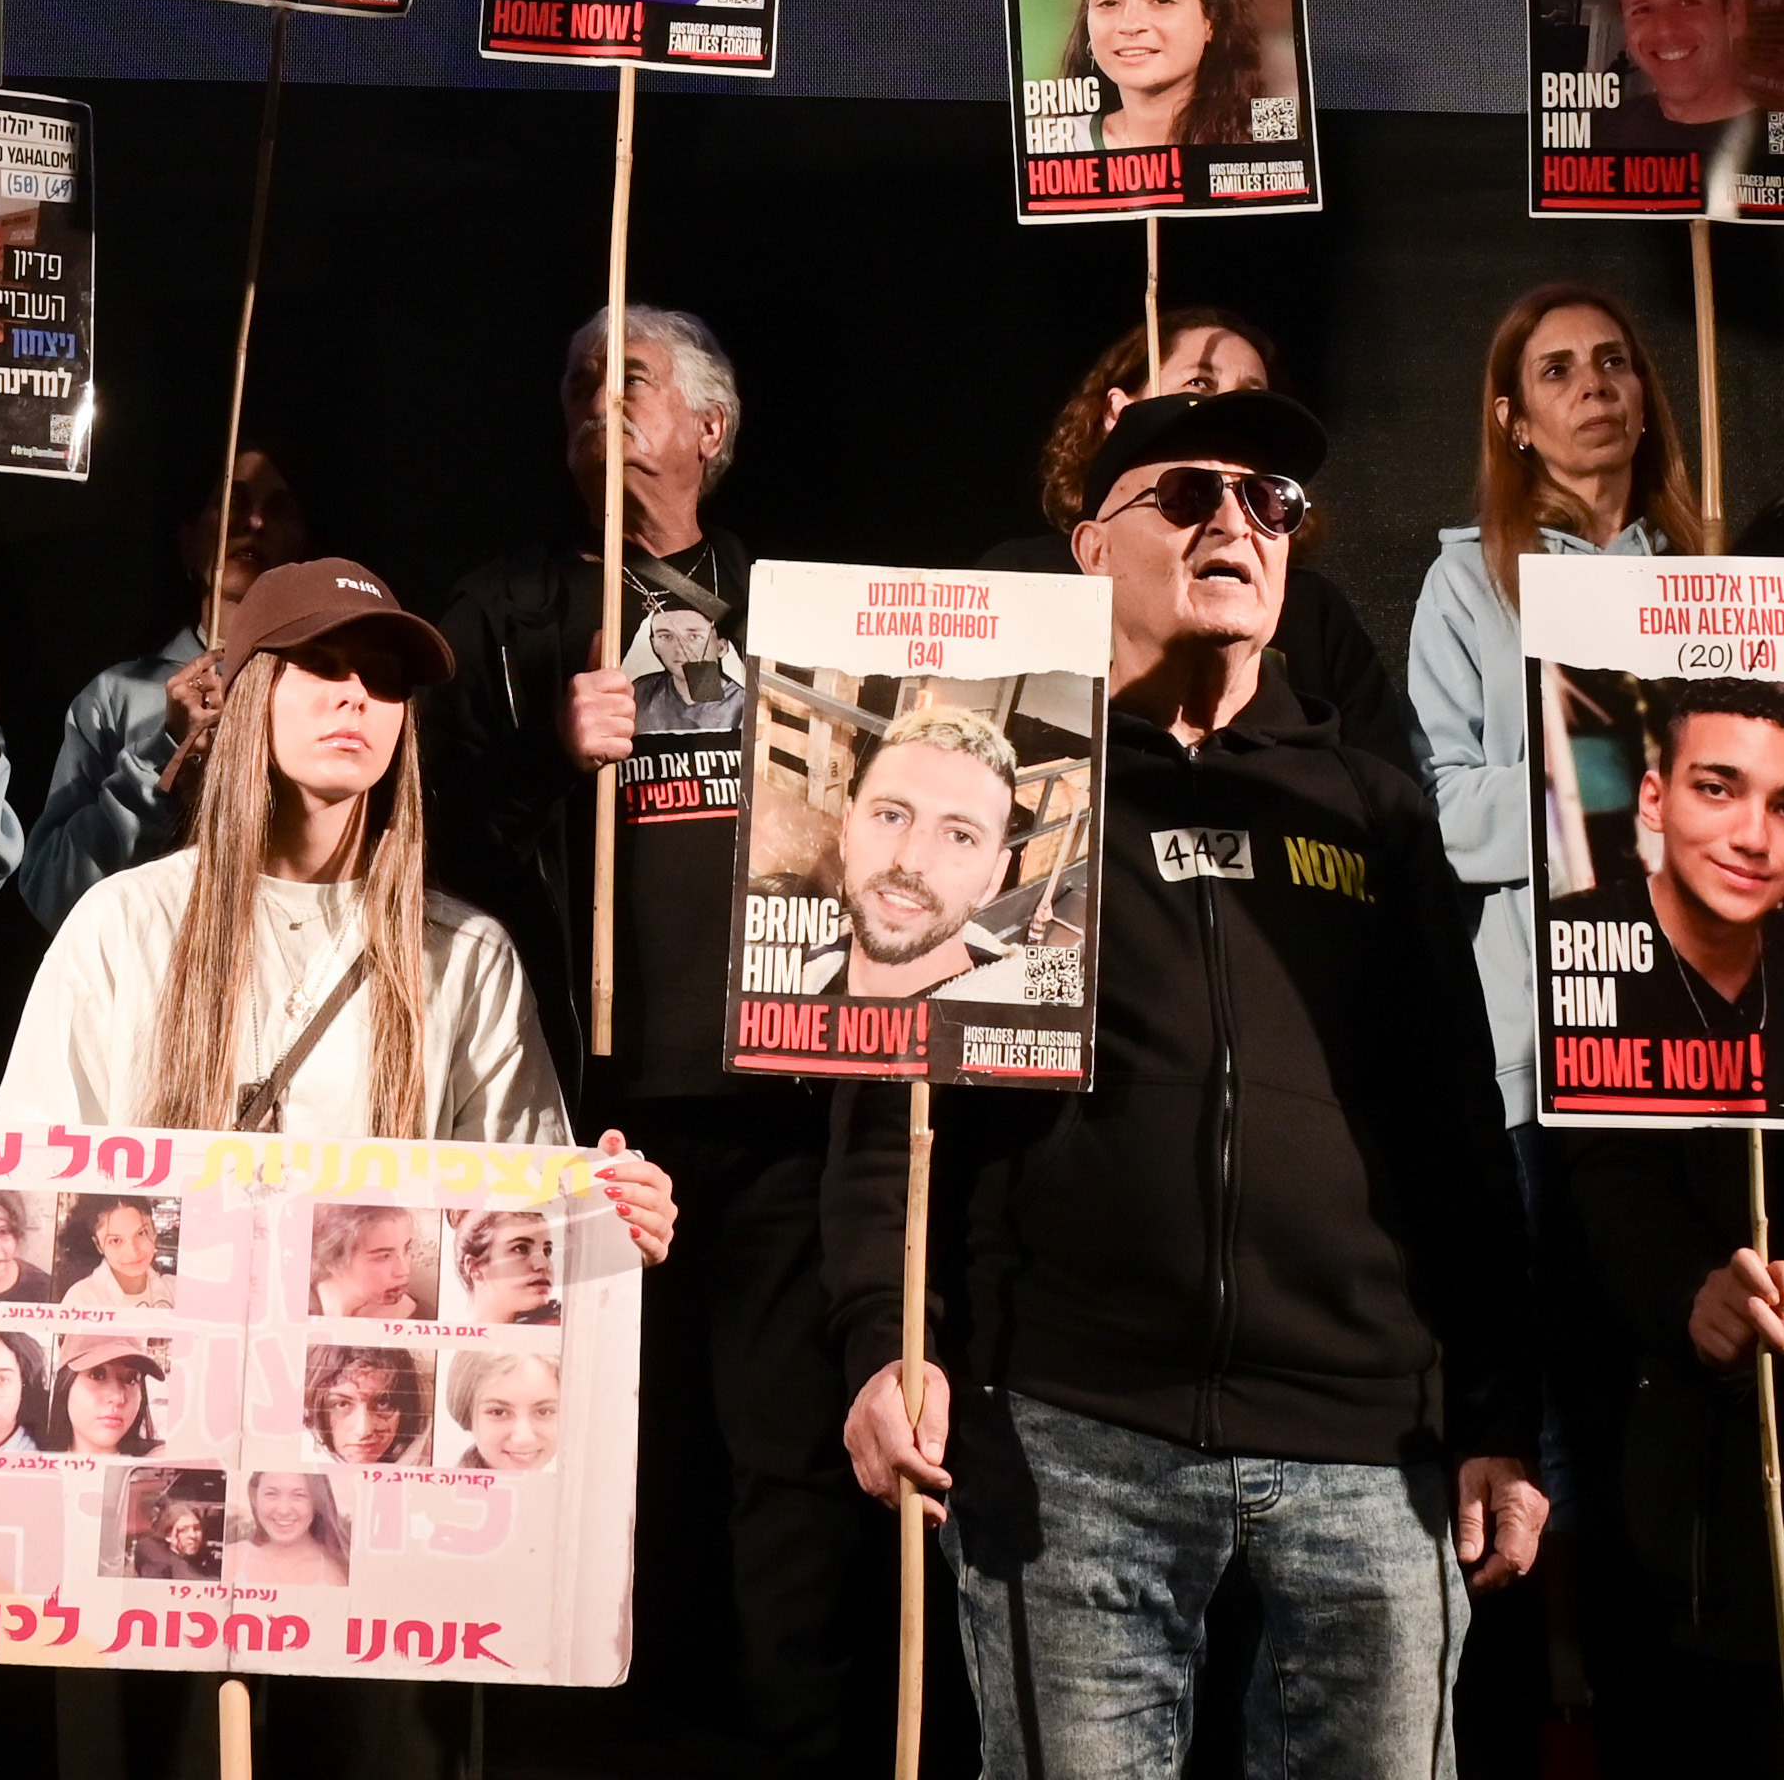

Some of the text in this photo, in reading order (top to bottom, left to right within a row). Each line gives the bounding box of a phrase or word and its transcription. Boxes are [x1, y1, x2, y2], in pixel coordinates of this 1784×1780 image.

[493, 0, 644, 43] HOME NOW!
[1024, 76, 1100, 116] BRING
[39, 119, 76, 143] אוהד
[1027, 117, 1076, 154] HER
[1542, 111, 1591, 149] HIM
[7, 146, 77, 170] YAHALOMI
[1028, 147, 1183, 196] HOME NOW!
[14, 250, 62, 281] פדיון
[12, 327, 75, 358] ניצחון
[336, 577, 382, 599] Faith
[868, 581, 990, 611] אלקנה בוחבוט
[1657, 574, 1741, 603] אלכסנדר
[856, 611, 999, 639] ELKANA BOHBOT
[1639, 607, 1693, 635] EDAN
[907, 640, 943, 668] (34)
[1677, 641, 1733, 673] (20)
[617, 752, 691, 788] את מתן
[638, 780, 700, 811] עכשיו
[963, 1025, 1081, 1048] HOSTAGES AND MISSING
[962, 1044, 1081, 1071] FAMILIES FORUM
[47, 1123, 173, 1189] נחל
[59, 1304, 116, 1322] דניאלה
[65, 1457, 96, 1471] לירי
[234, 1588, 277, 1602] נעמה
[97, 1608, 310, 1655] מחכות
[346, 1617, 516, 1670] אנחנו
